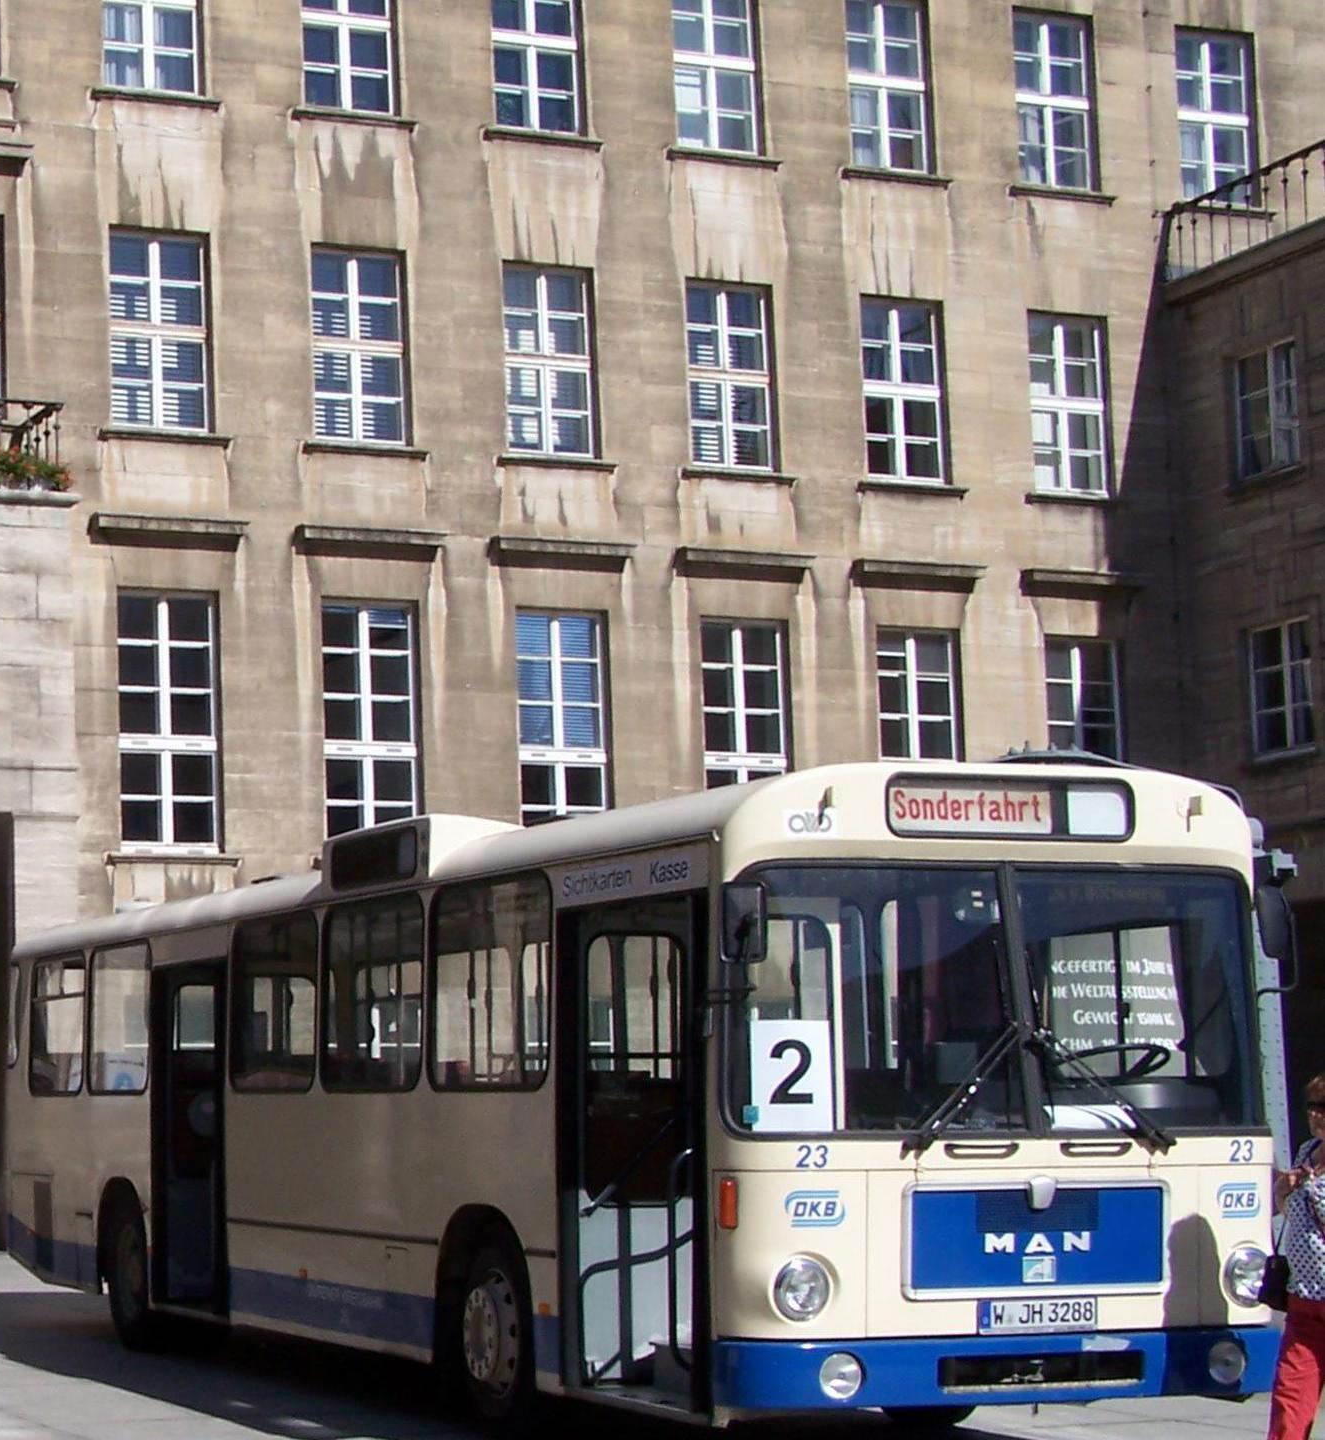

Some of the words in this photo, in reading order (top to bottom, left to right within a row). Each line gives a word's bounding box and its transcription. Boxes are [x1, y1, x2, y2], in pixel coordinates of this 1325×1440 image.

[893, 788, 1042, 822] Sonderfahrt
[562, 868, 633, 897] Sichtkarten
[649, 860, 689, 885] Kasse
[769, 1038, 814, 1105] 2
[795, 1144, 829, 1169] 23
[1229, 1139, 1254, 1162] 23
[793, 1200, 838, 1217] OKB
[1222, 1192, 1257, 1209] OKB
[984, 1231, 1091, 1253] MAN
[993, 1304, 1005, 1325] W
[1019, 1303, 1044, 1324] JH
[1048, 1300, 1093, 1323] 3288
